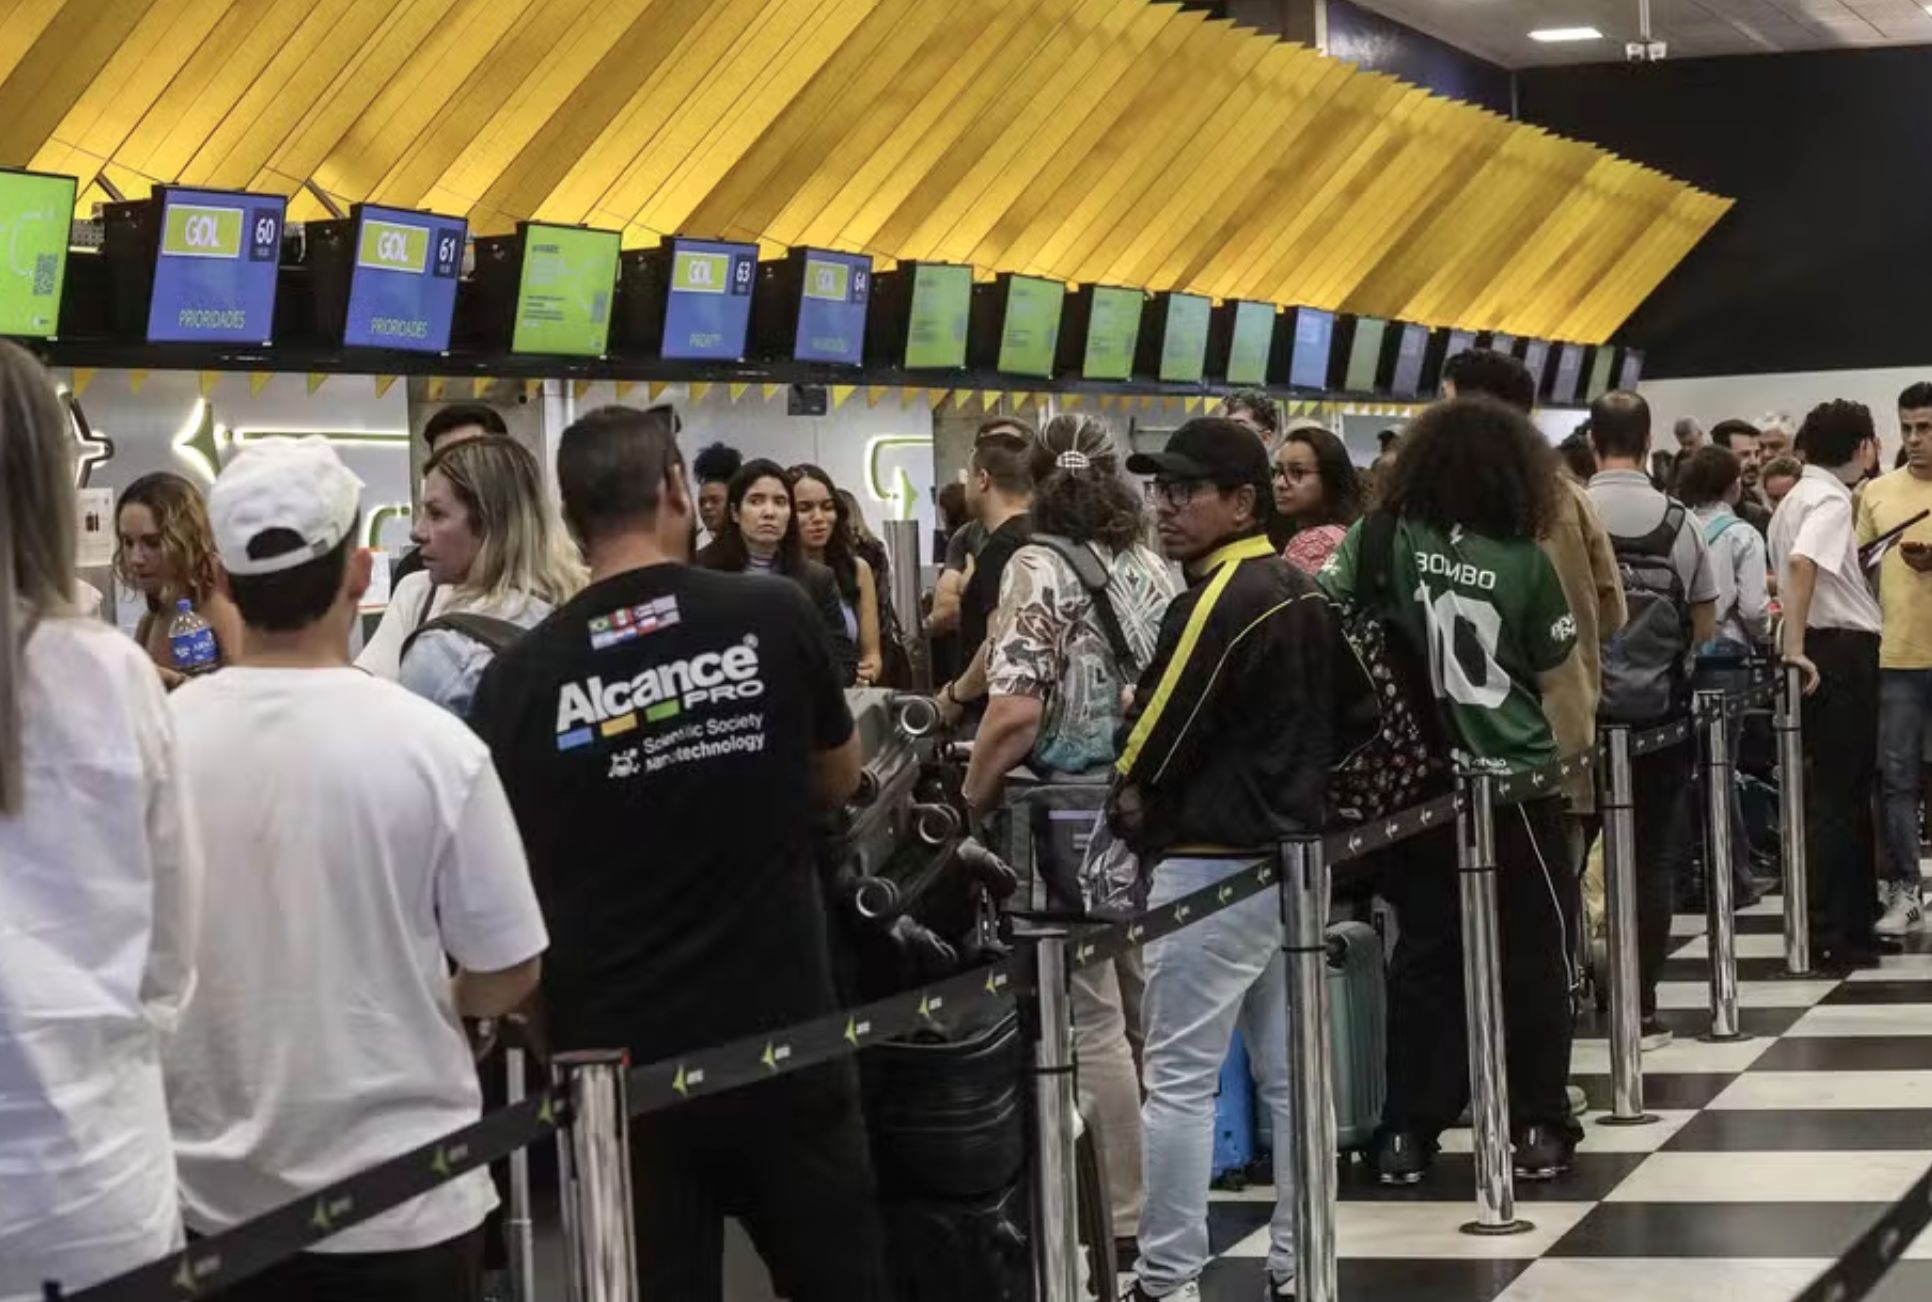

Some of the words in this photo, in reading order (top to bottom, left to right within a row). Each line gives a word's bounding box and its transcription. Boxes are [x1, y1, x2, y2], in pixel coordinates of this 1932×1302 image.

[184, 214, 220, 247] GOL
[256, 218, 276, 244] 60
[377, 232, 408, 263] GOL
[440, 238, 456, 262] 61
[689, 259, 713, 284] GOL
[737, 261, 750, 283] 63
[178, 310, 247, 329] PRIORIDADES
[371, 317, 428, 339] PRIORIDADES
[1414, 578, 1511, 709] 10
[556, 644, 759, 732] Alcance
[684, 679, 765, 710] PRO
[706, 713, 763, 735] Society
